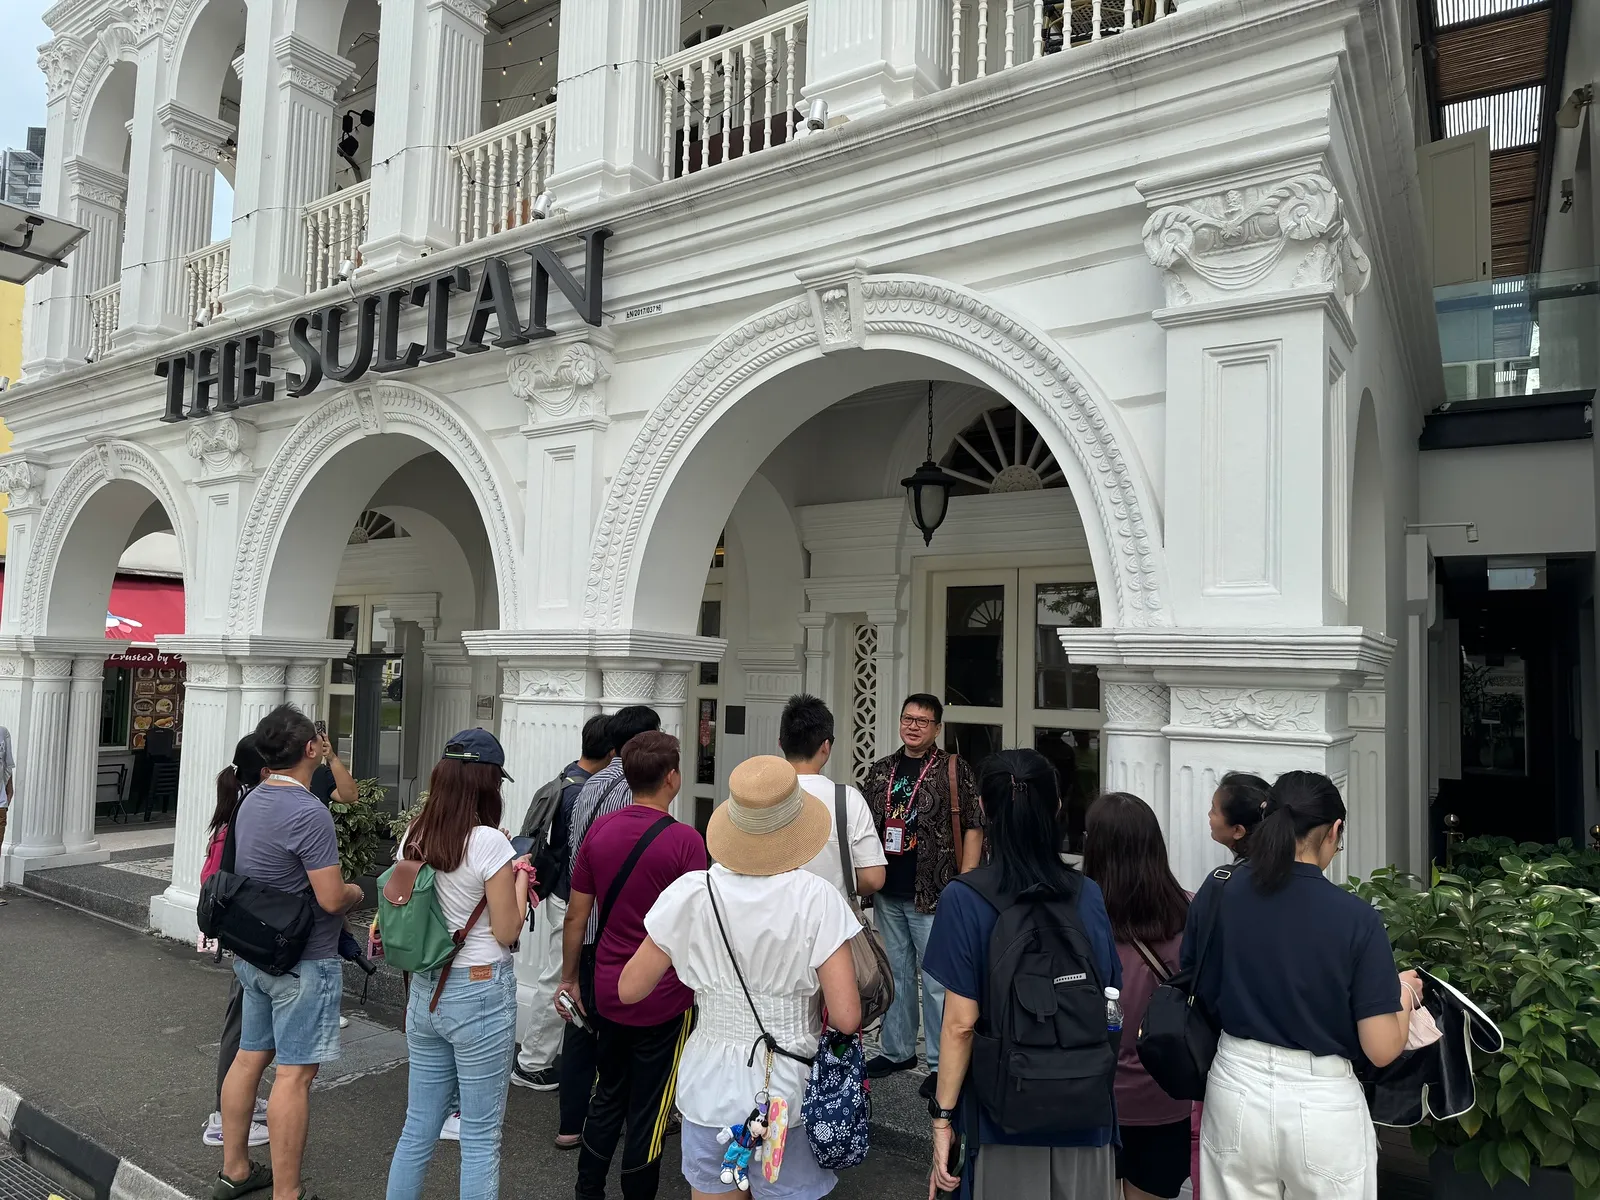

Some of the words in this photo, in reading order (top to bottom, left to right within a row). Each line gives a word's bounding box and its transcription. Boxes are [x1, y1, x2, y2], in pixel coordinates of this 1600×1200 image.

[154, 327, 276, 422] THE
[285, 227, 614, 399] SULTAN
[157, 653, 168, 665] by
